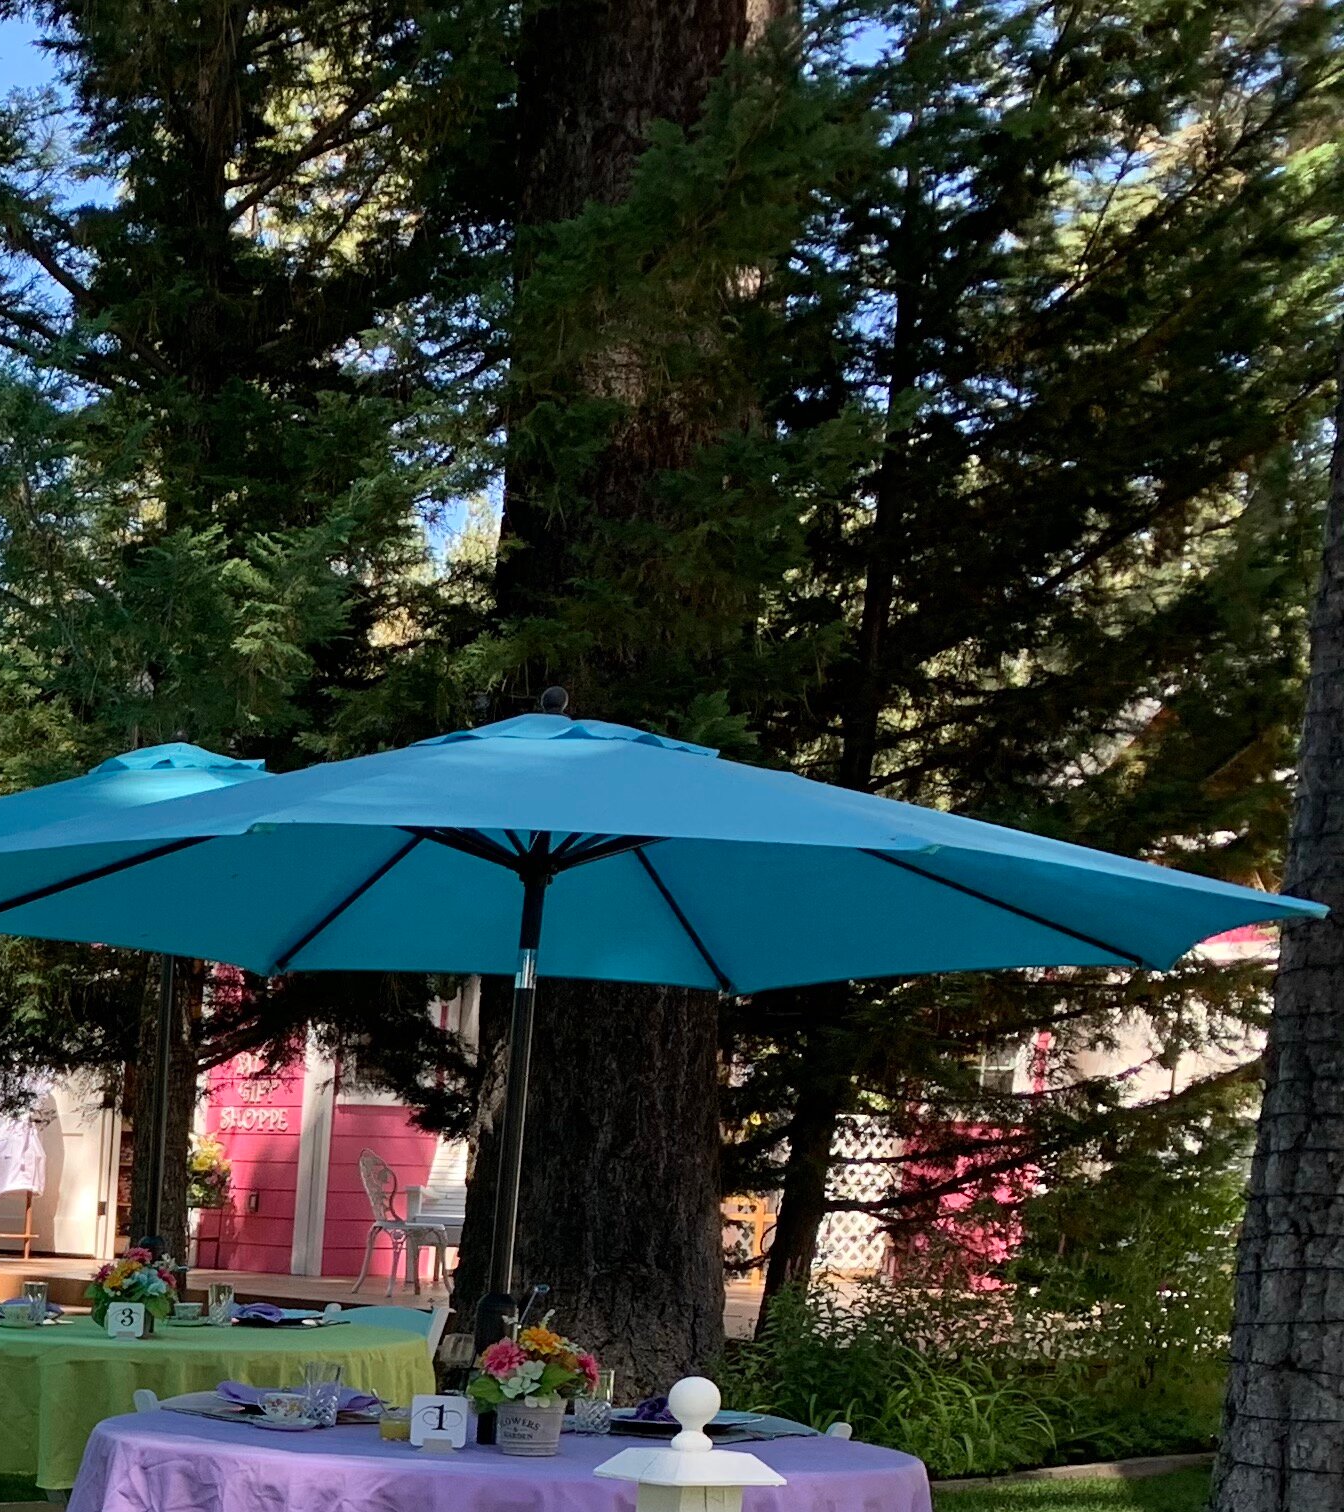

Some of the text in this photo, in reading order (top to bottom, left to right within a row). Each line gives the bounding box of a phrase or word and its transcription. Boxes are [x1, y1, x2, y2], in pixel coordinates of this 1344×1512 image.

[220, 1106, 288, 1131] SHOPPE
[121, 1308, 134, 1327] 3
[431, 1404, 448, 1431] 1
[498, 1416, 541, 1432] LOWERS
